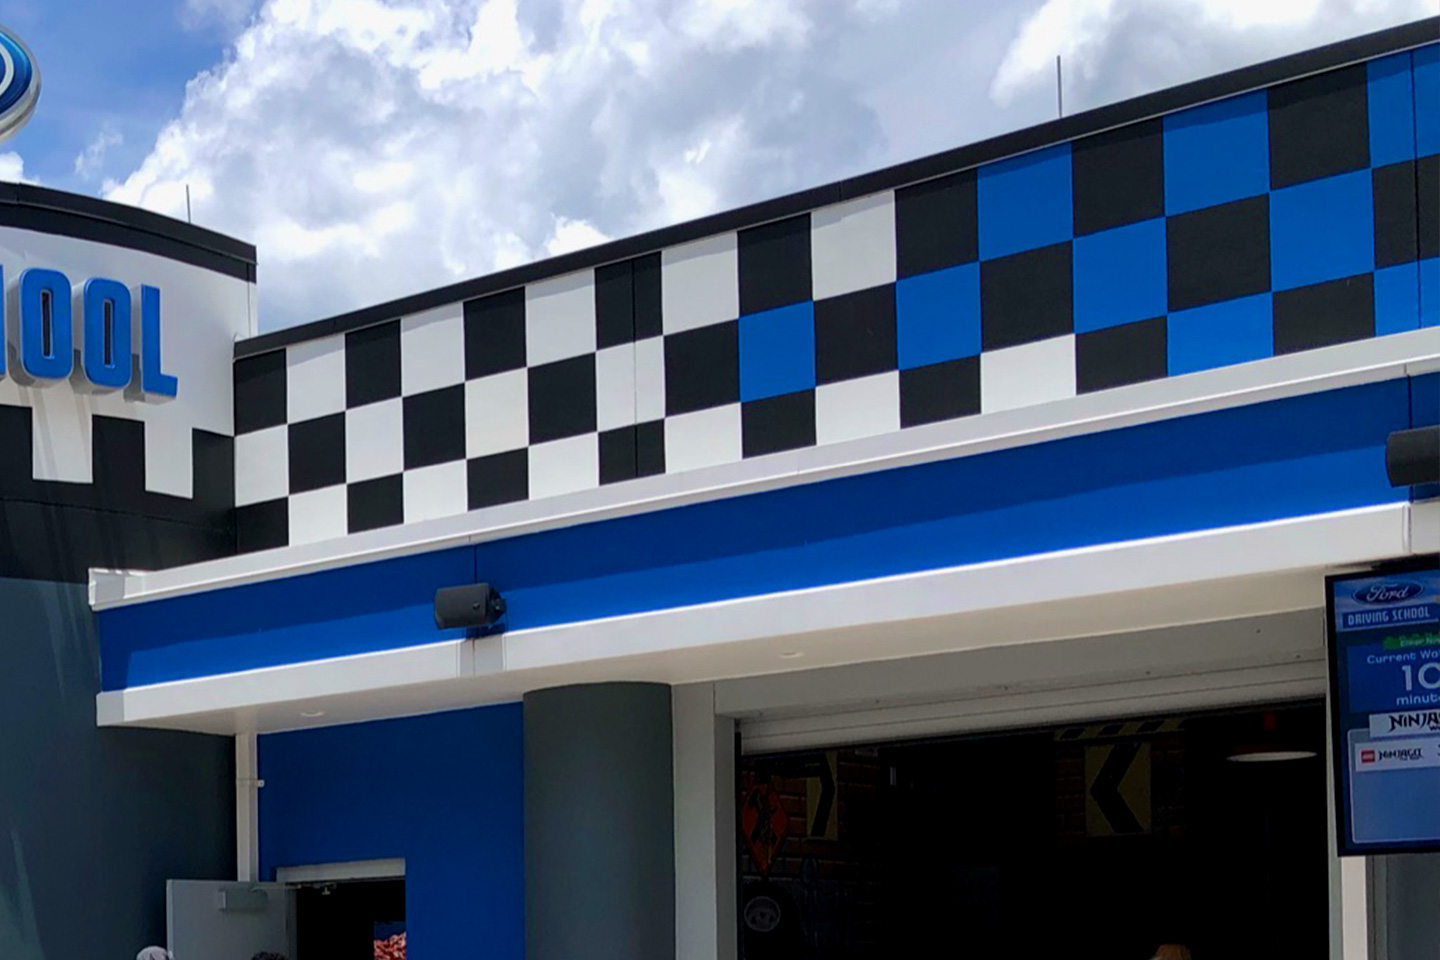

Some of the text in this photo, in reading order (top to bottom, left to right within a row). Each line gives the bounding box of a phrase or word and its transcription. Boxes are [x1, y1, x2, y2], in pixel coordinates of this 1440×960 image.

[1366, 583, 1410, 601] Ford
[1347, 606, 1431, 626] DRIVING SCHOOL
[1366, 648, 1440, 665] Current Wa
[1396, 693, 1440, 706] minut
[1387, 711, 1440, 733] NINJA
